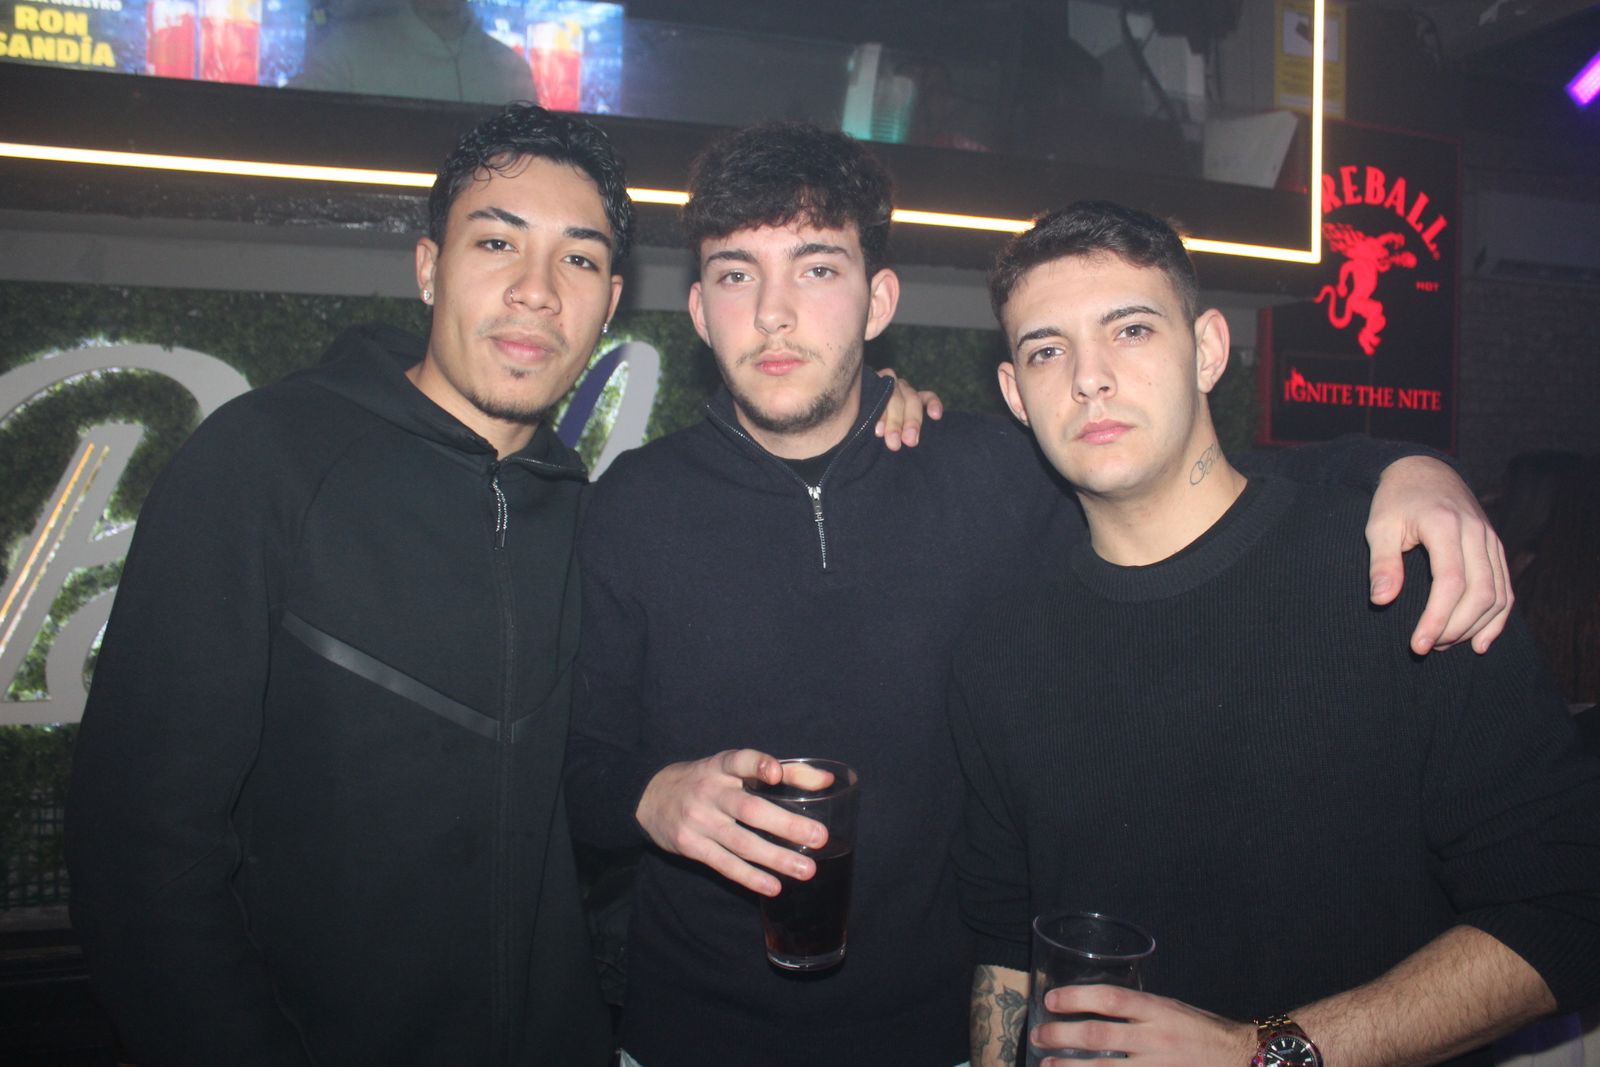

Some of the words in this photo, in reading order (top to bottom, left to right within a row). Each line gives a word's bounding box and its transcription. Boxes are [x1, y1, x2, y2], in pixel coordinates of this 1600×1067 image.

[15, 5, 88, 36] RON
[1322, 165, 1448, 253] REBALL
[1284, 367, 1352, 405] IGNITE
[1355, 384, 1394, 408] THE
[1398, 388, 1441, 411] NITE
